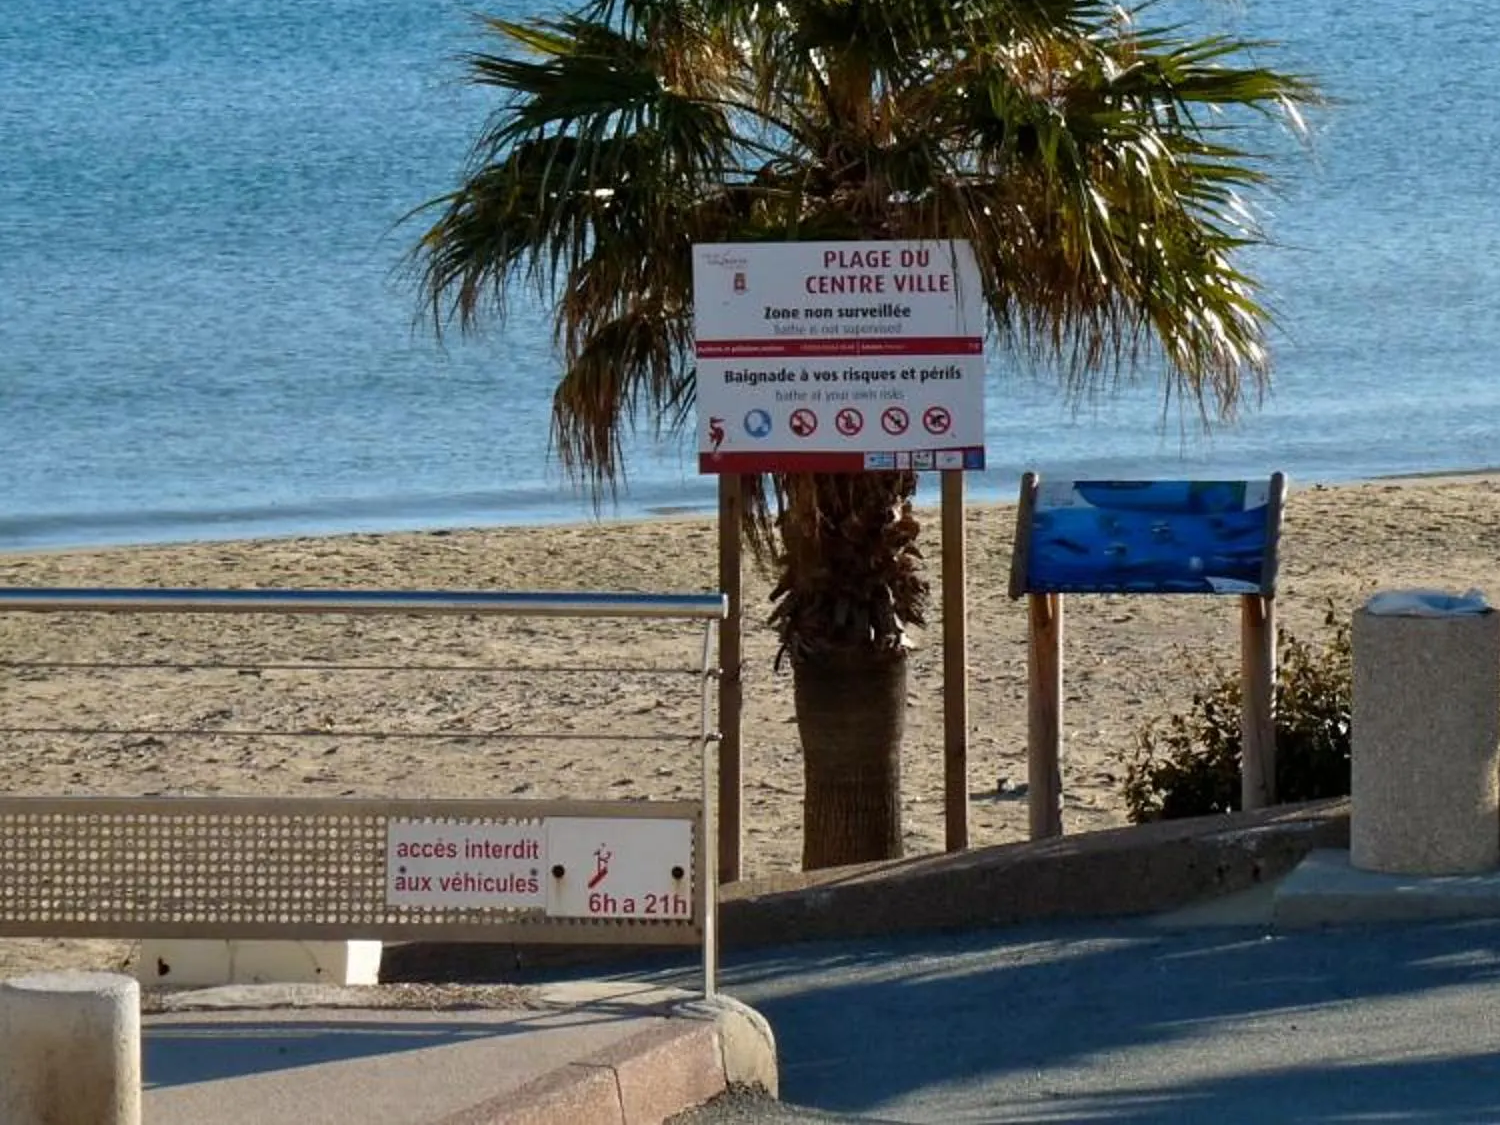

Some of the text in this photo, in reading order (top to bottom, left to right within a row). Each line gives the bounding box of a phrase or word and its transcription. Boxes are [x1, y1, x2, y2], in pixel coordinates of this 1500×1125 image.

[823, 250, 930, 268] PLAGE DU
[805, 274, 950, 294] CENTRE VILLE
[764, 303, 911, 320] Zone non surveillée
[724, 368, 796, 386] Baignade
[813, 370, 839, 382] vos
[843, 367, 896, 384] risques
[901, 367, 916, 381] et
[920, 365, 963, 383] périls
[397, 837, 539, 860] accès interdit
[395, 871, 539, 893] aux véhicules
[589, 893, 617, 914] 6h
[644, 894, 687, 915] 21h
